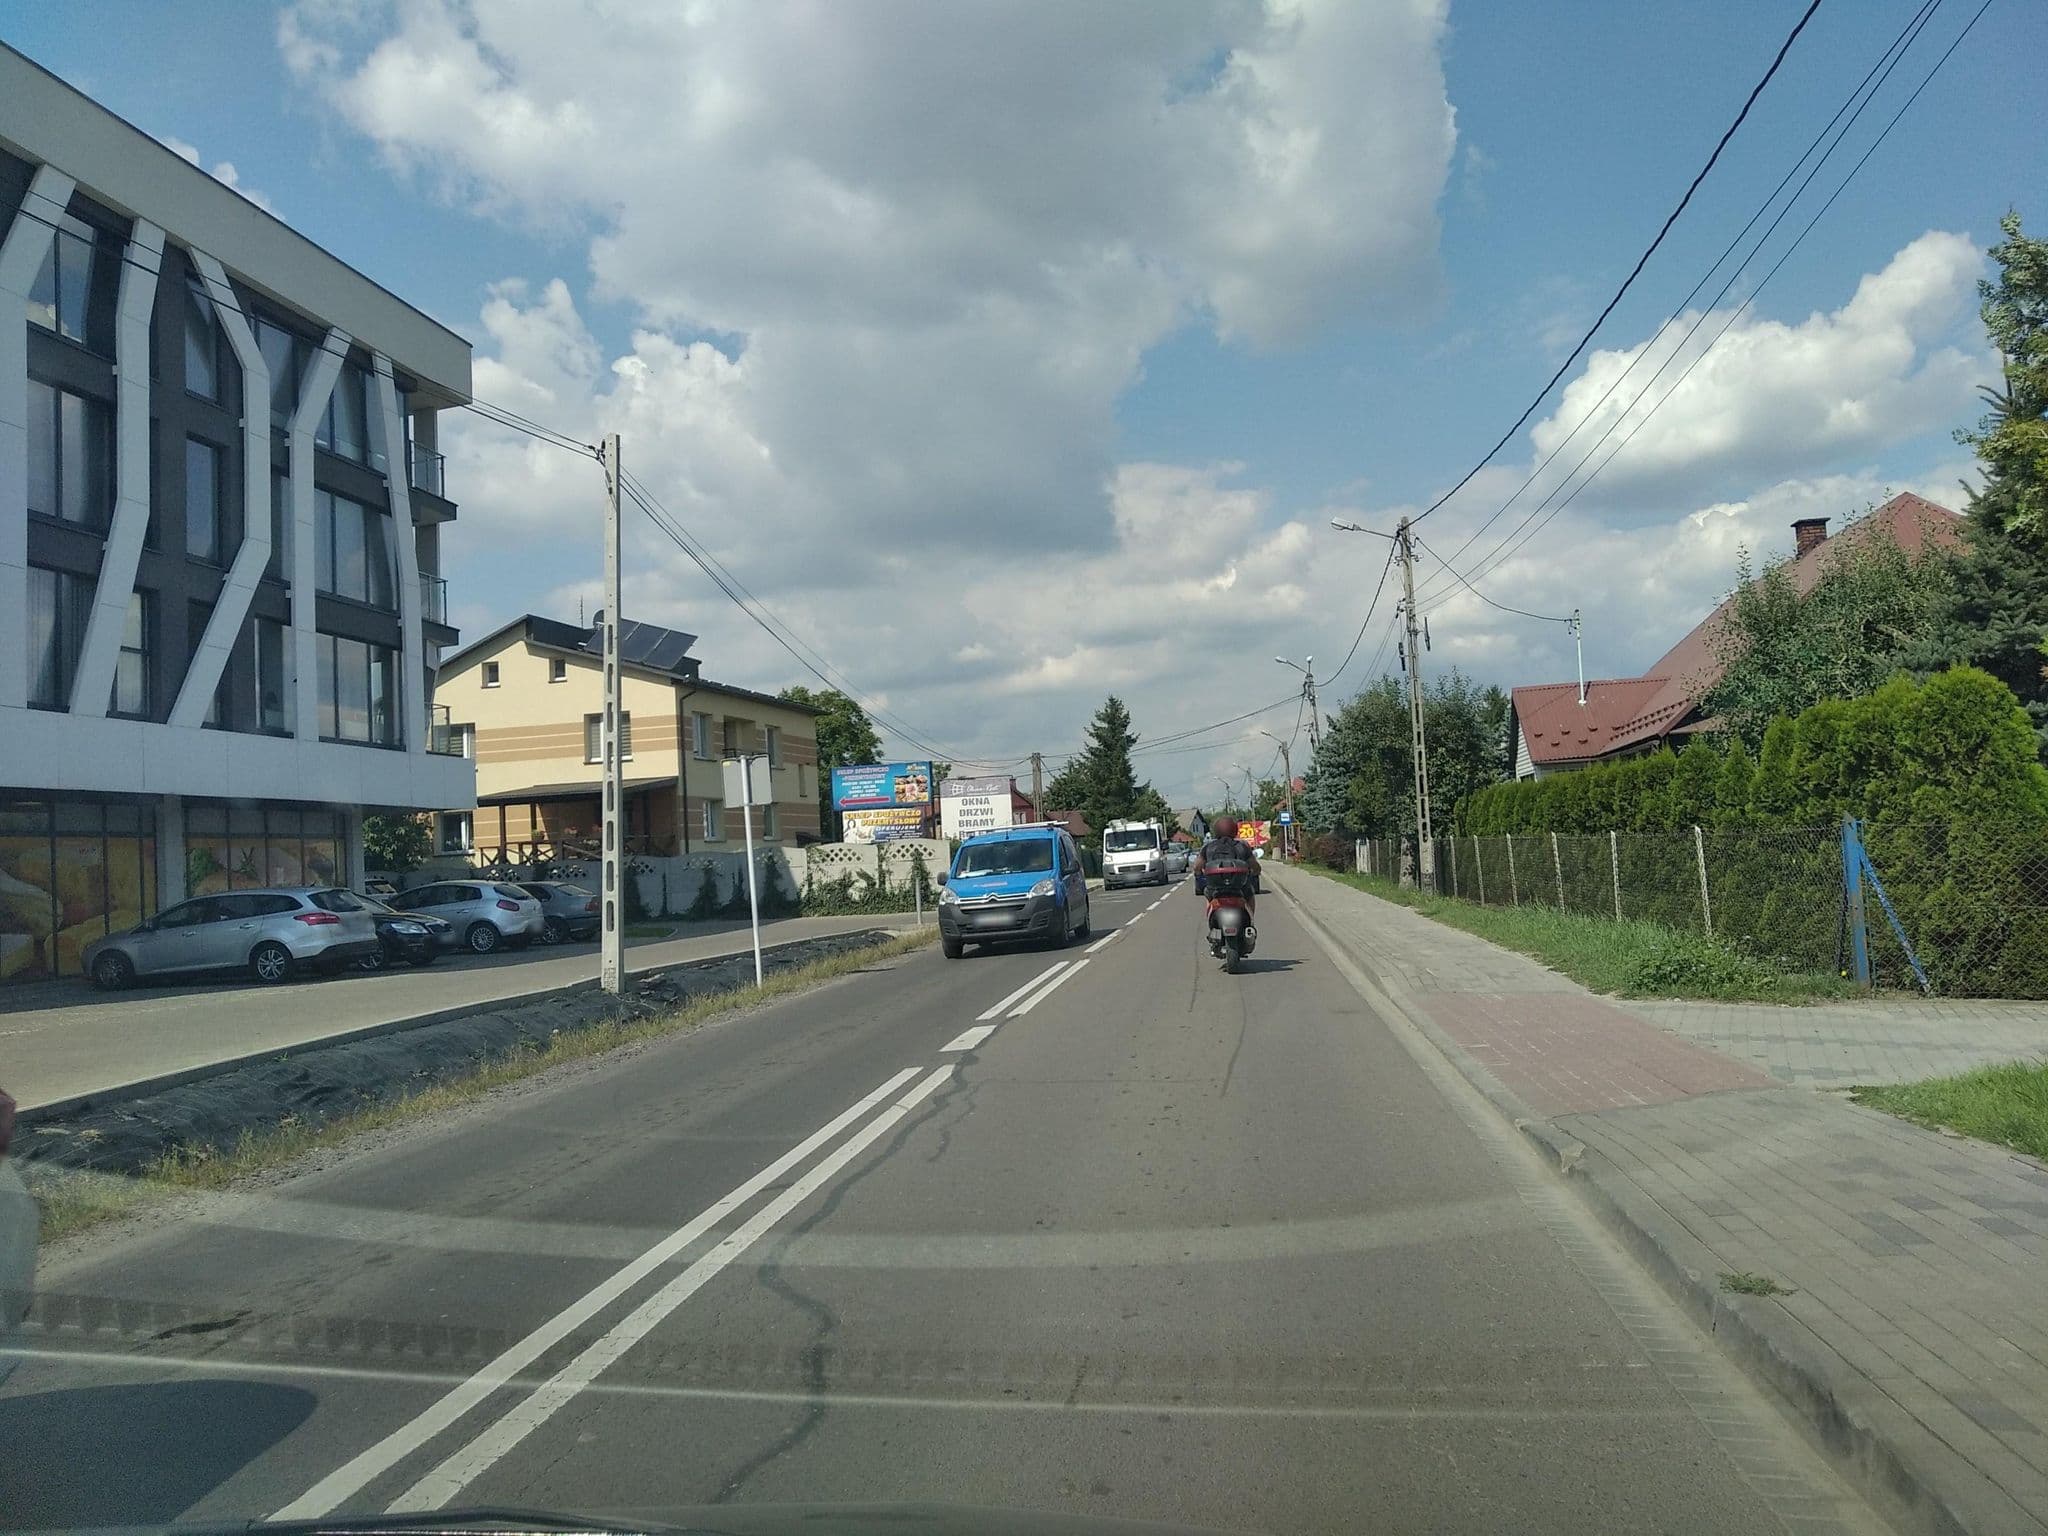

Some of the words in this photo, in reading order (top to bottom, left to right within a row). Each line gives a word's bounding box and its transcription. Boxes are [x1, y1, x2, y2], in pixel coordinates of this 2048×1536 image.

[961, 797, 990, 806] OKNA
[959, 807, 994, 817] DRZWI
[958, 818, 995, 827] BRAMY
[1239, 827, 1254, 838] 20
